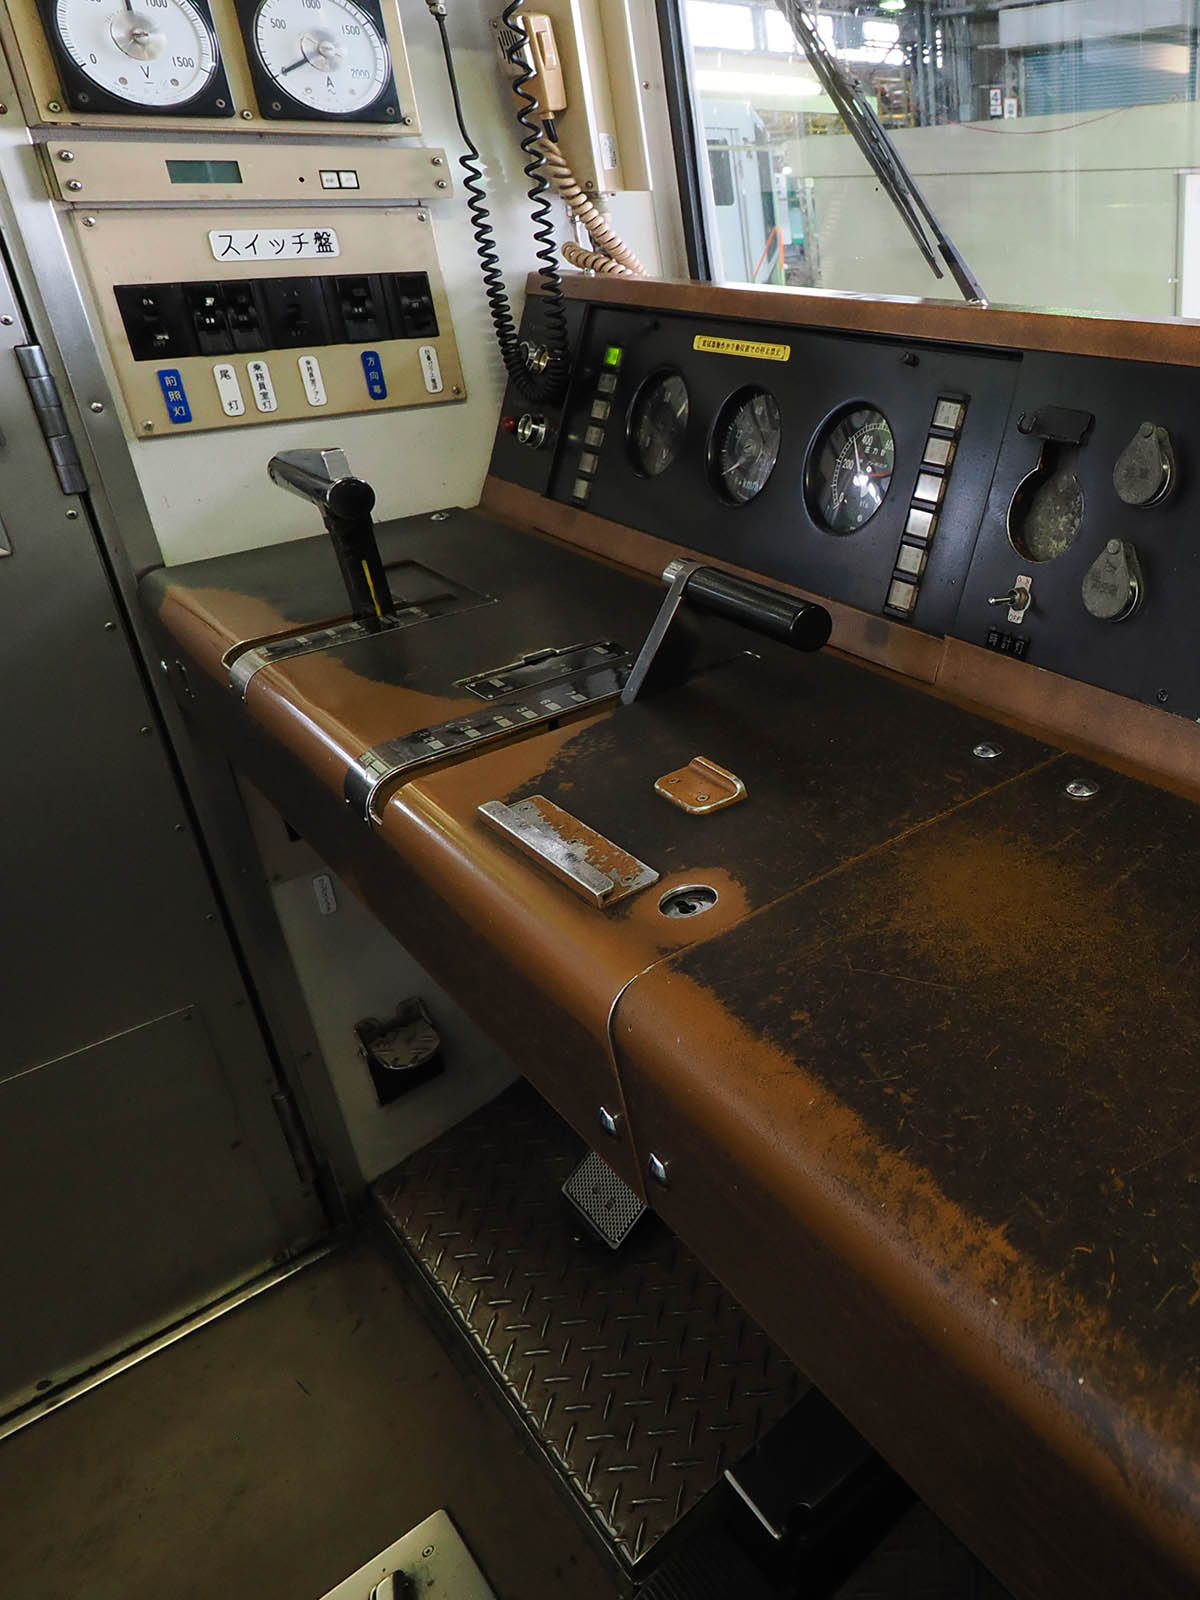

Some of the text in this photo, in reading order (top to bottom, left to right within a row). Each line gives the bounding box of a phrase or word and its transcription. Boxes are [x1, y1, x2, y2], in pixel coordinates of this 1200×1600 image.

[270, 18, 286, 29] 500
[341, 25, 360, 35] 1500
[89, 53, 97, 64] 0
[172, 56, 194, 68] 1500
[140, 65, 149, 79] V
[350, 68, 370, 79] 2000
[326, 75, 335, 88] A
[218, 231, 335, 258] スイッチ盤
[219, 369, 239, 411] 尾灯
[164, 376, 186, 417] 前照灯
